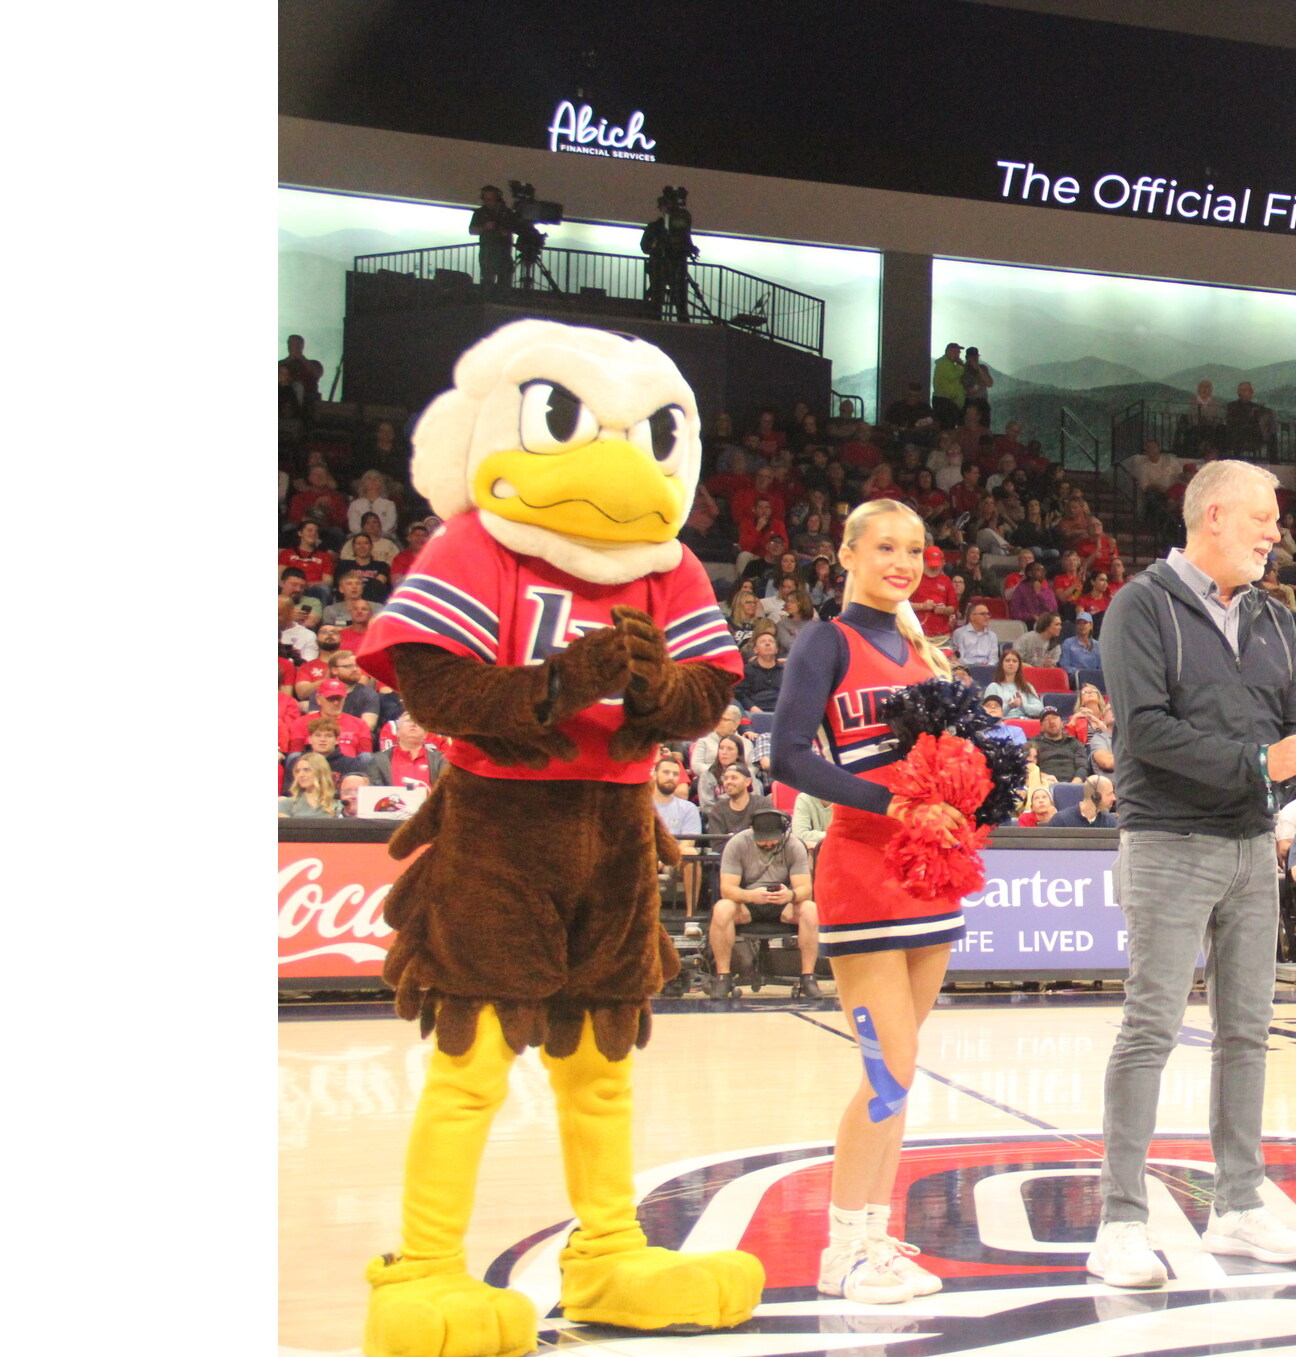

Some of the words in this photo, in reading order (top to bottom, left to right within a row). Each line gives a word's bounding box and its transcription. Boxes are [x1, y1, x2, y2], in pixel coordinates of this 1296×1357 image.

[547, 100, 657, 152] Abich
[560, 144, 610, 157] FINANCIAL
[612, 150, 656, 162] SERVICES
[997, 160, 1080, 204] The
[1094, 173, 1251, 224] Official
[950, 931, 994, 952] IFE
[1018, 931, 1094, 952] LIVED
